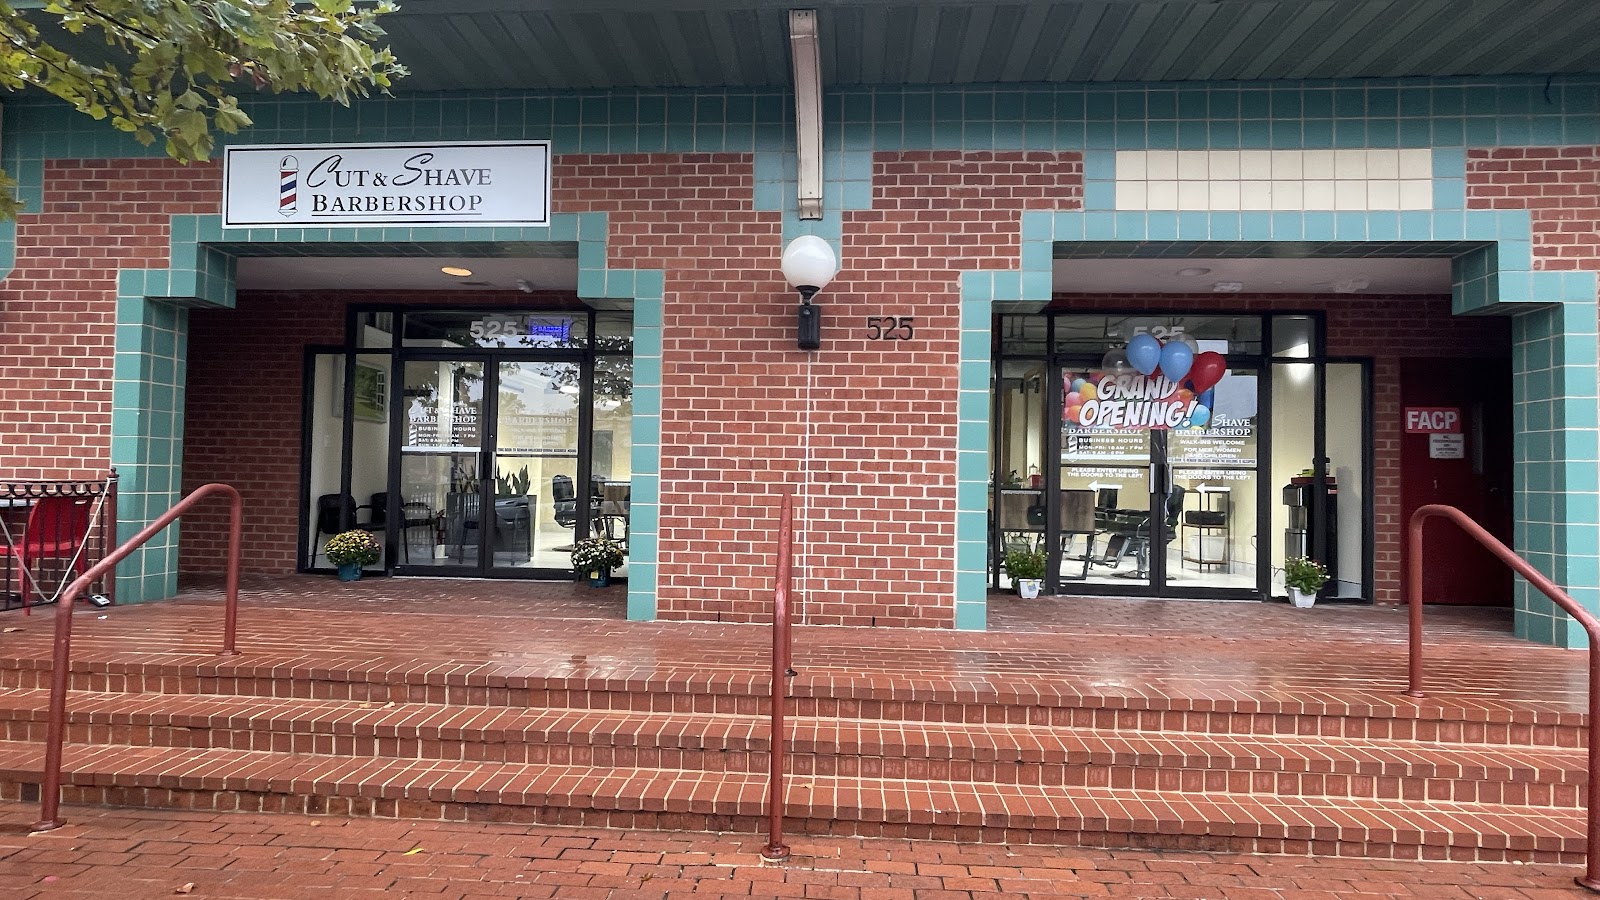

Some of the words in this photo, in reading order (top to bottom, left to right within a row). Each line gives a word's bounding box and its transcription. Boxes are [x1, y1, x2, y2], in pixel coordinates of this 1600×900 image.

[306, 154, 370, 188] CUT
[373, 171, 387, 187] &
[392, 153, 492, 187] SHAVE
[312, 194, 483, 213] BARBERSHOP
[469, 320, 518, 339] 525
[867, 316, 914, 341] 525
[1096, 374, 1179, 400] GRAND
[1078, 399, 1198, 428] OPENING!
[1212, 413, 1251, 427] SHAVE
[1407, 411, 1458, 430] FACP
